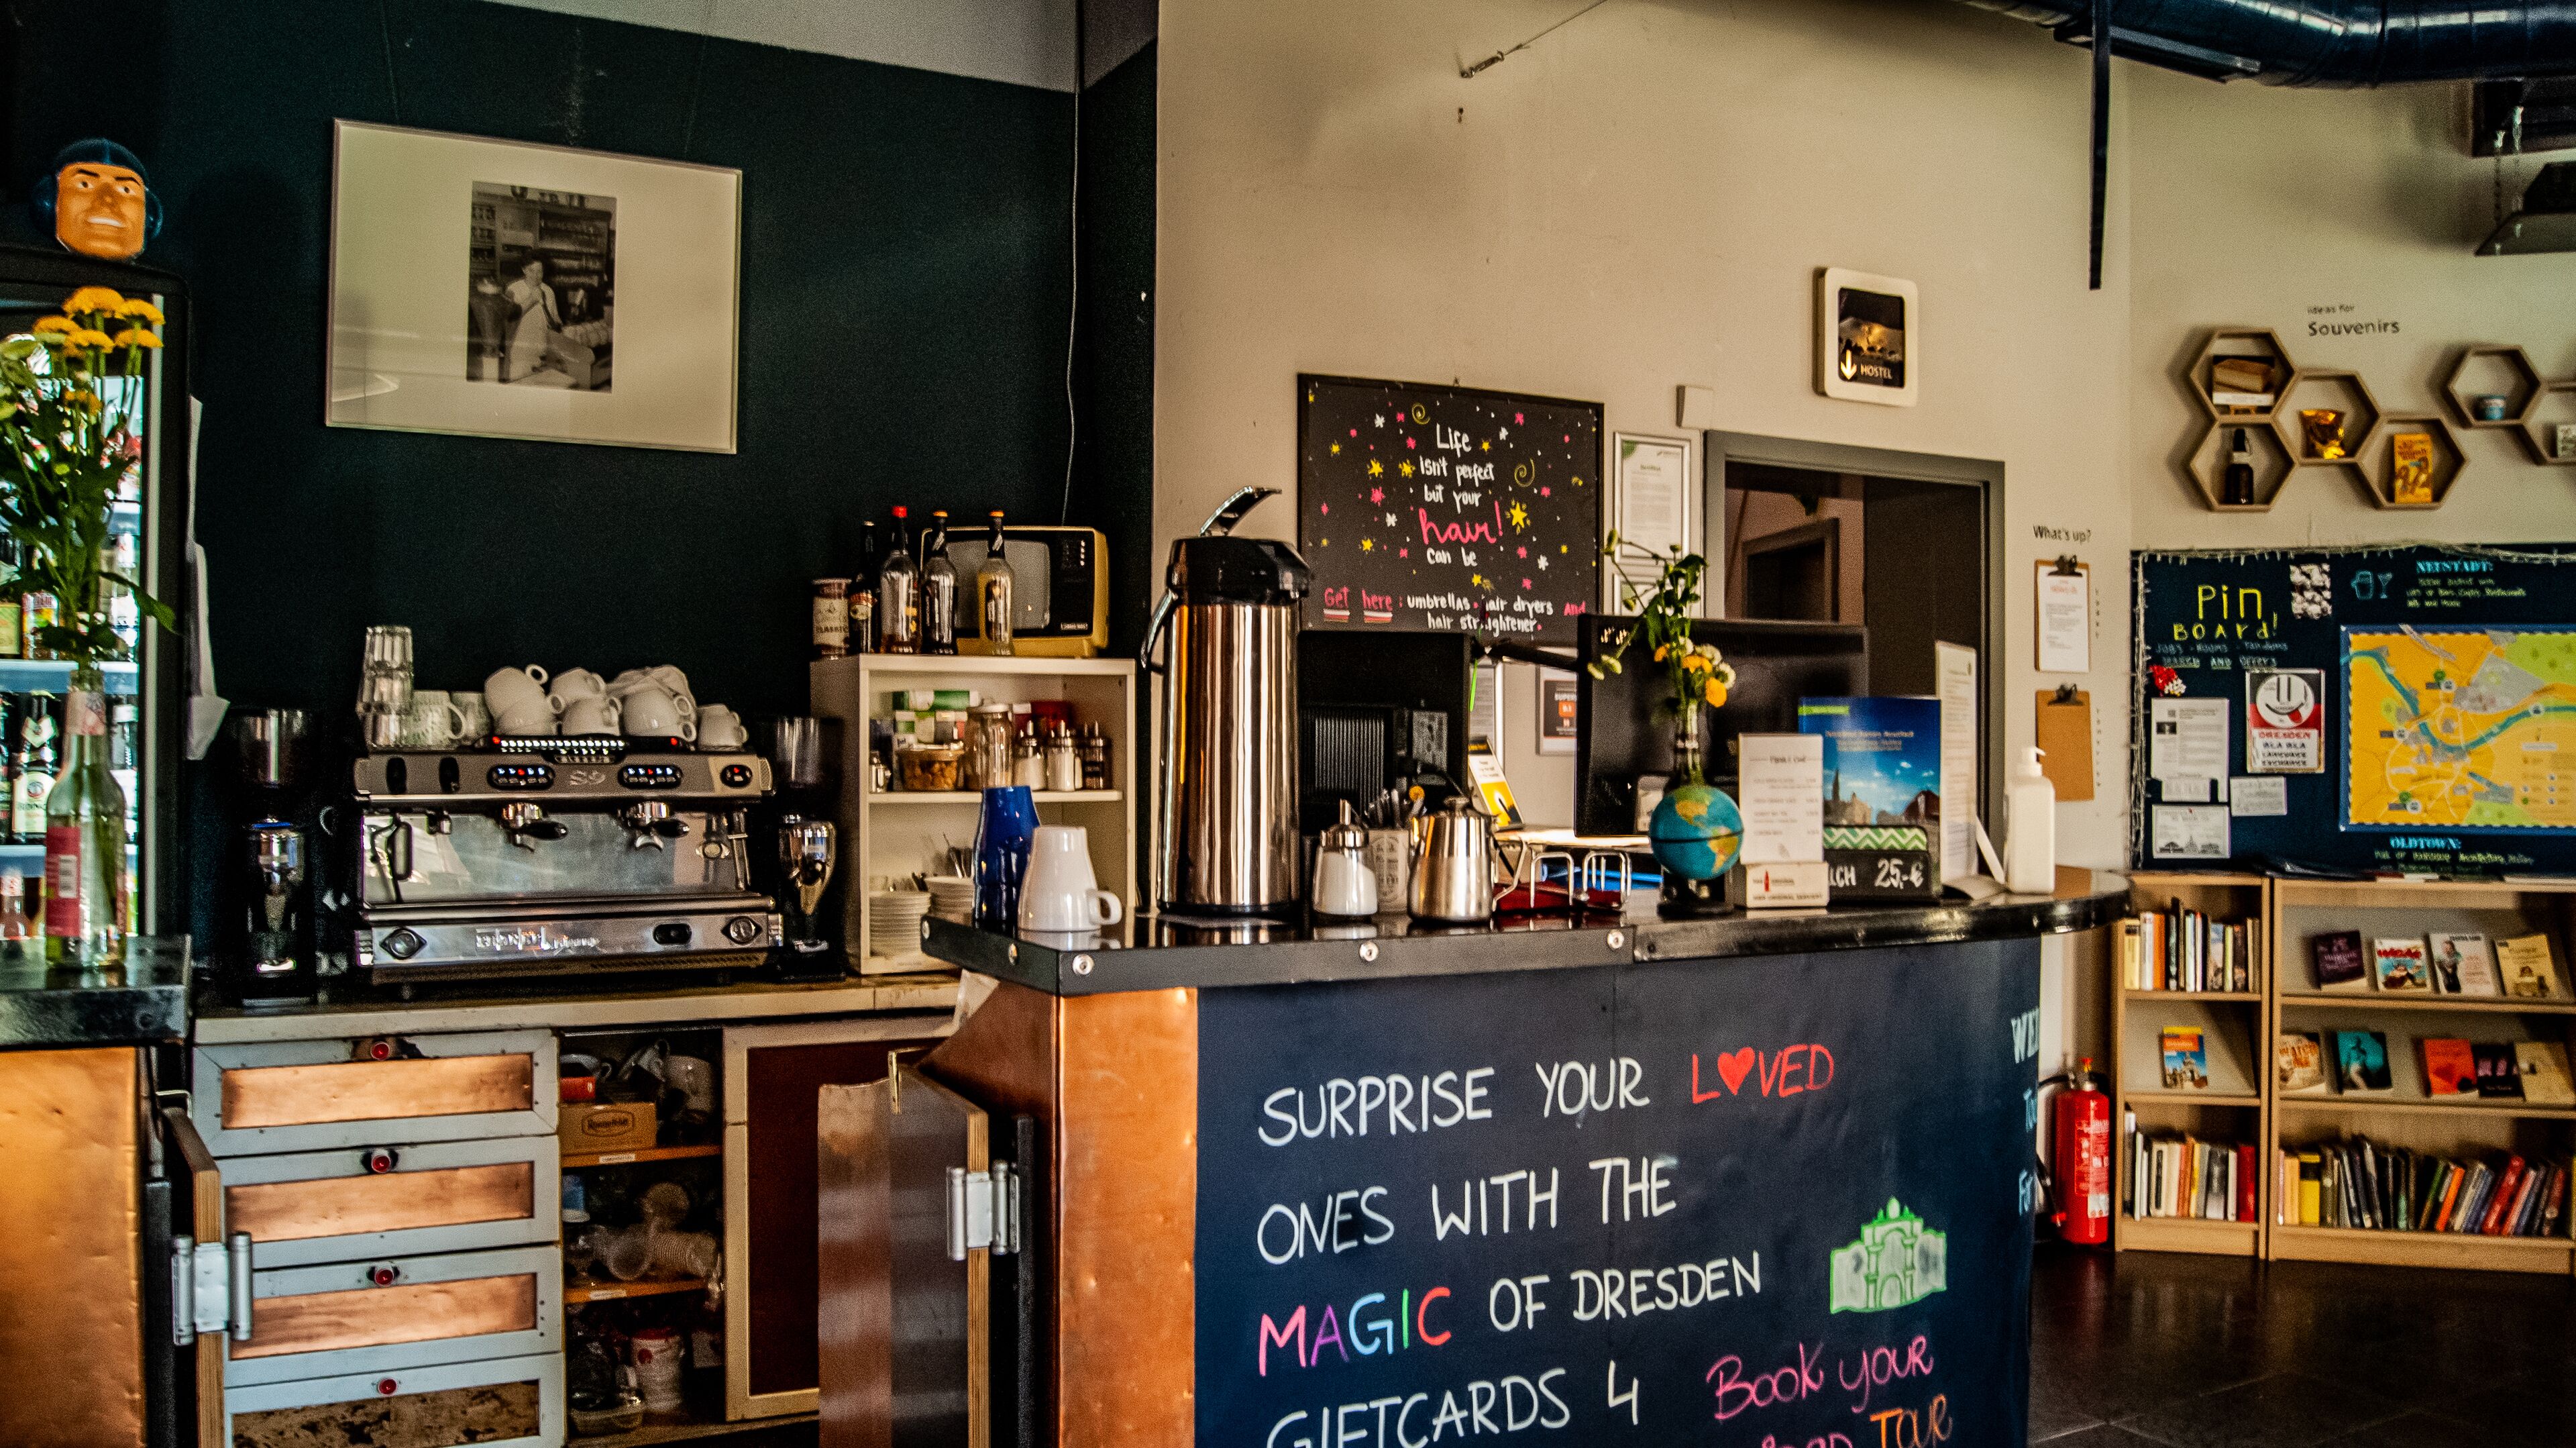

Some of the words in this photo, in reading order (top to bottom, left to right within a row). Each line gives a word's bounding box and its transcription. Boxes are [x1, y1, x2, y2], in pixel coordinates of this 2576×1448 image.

[2308, 320, 2400, 336] Souvenirs
[1860, 364, 1892, 380] HOSTEL
[1436, 423, 1472, 458] Life
[1456, 462, 1495, 487] perfect
[1424, 483, 1444, 503] but
[1452, 490, 1482, 514] your
[1427, 547, 1452, 565] can
[1462, 546, 1478, 567] be
[2198, 584, 2262, 620] Pin
[1428, 611, 1454, 630] hair
[1258, 1067, 1495, 1147] SURPRISE
[1536, 1057, 1650, 1118] YOUR
[1257, 1186, 1395, 1265] ONES
[1432, 1167, 1558, 1241] WITH
[1589, 1156, 1677, 1225] THE
[1258, 1286, 1452, 1377] MAGIC
[1489, 1270, 1550, 1332] OF
[1570, 1250, 1762, 1322] DRESDEN
[1608, 1359, 1640, 1425] 4
